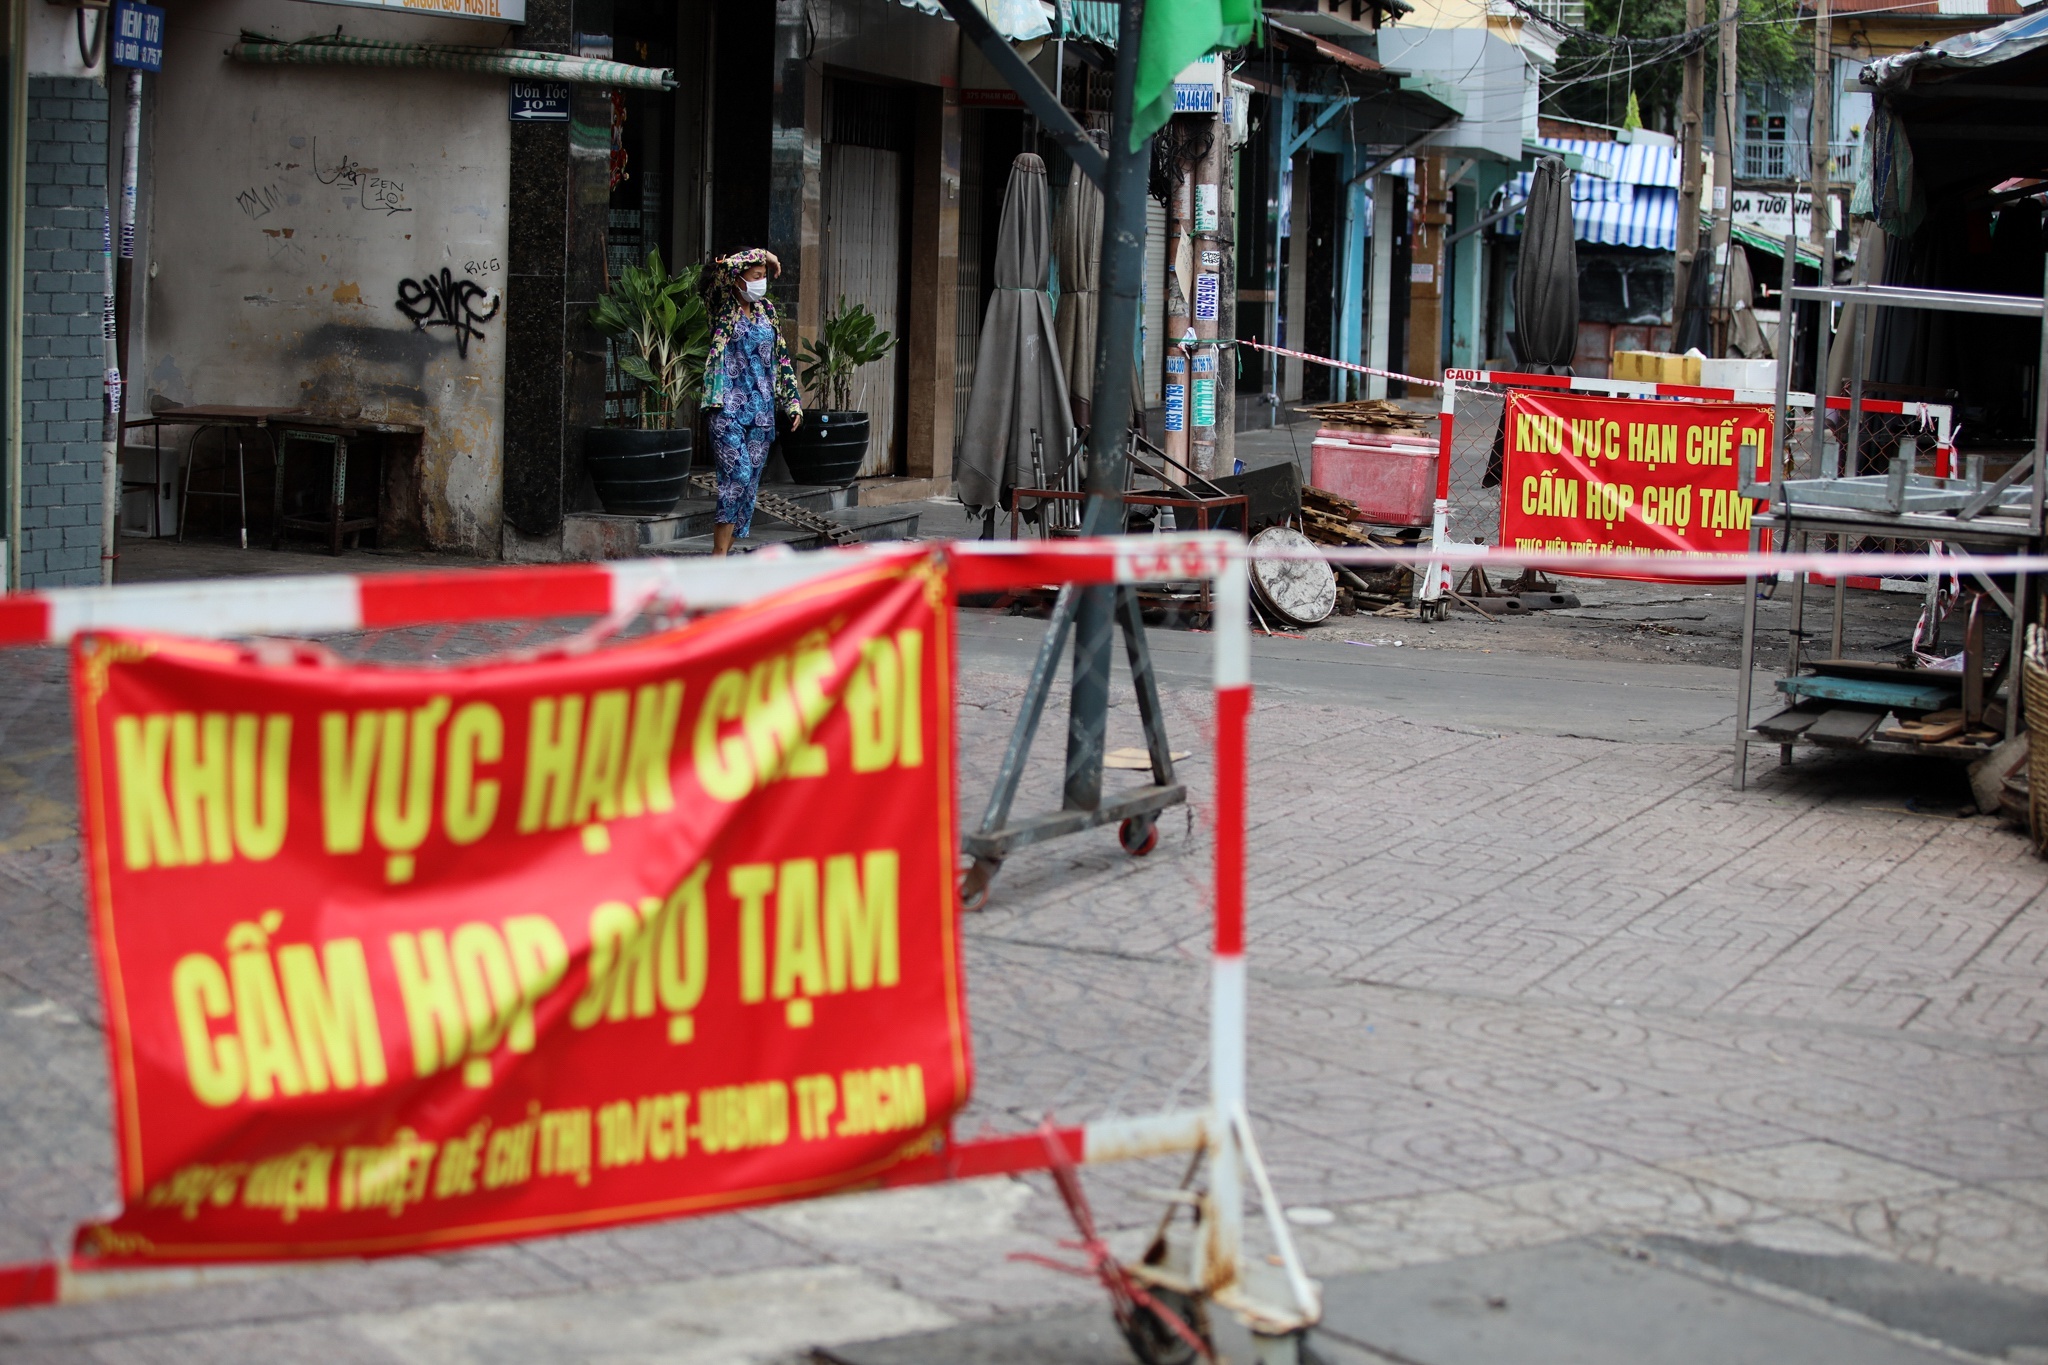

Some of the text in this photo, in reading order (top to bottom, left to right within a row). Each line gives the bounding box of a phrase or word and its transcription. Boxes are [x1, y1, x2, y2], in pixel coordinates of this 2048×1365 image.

[146, 14, 160, 43] 373
[514, 80, 568, 99] Uốn Tóc
[522, 100, 544, 109] 10
[1733, 199, 1751, 213] OA
[1445, 369, 1482, 381] CAQ1
[1516, 413, 1563, 454] KHU
[1571, 418, 1620, 467] VỰC
[1628, 422, 1678, 471] HẠN
[1686, 417, 1739, 466] CHẾ
[1522, 468, 1752, 538] CẤM HỌP CHỢ TẠM
[114, 612, 924, 884] KHU VỰC HẠN CHẾ ĐI
[170, 849, 900, 1109] CẤM HỌP CHỢ TẠM
[434, 1114, 493, 1199] ĐỂ
[537, 1106, 592, 1187] THỊ
